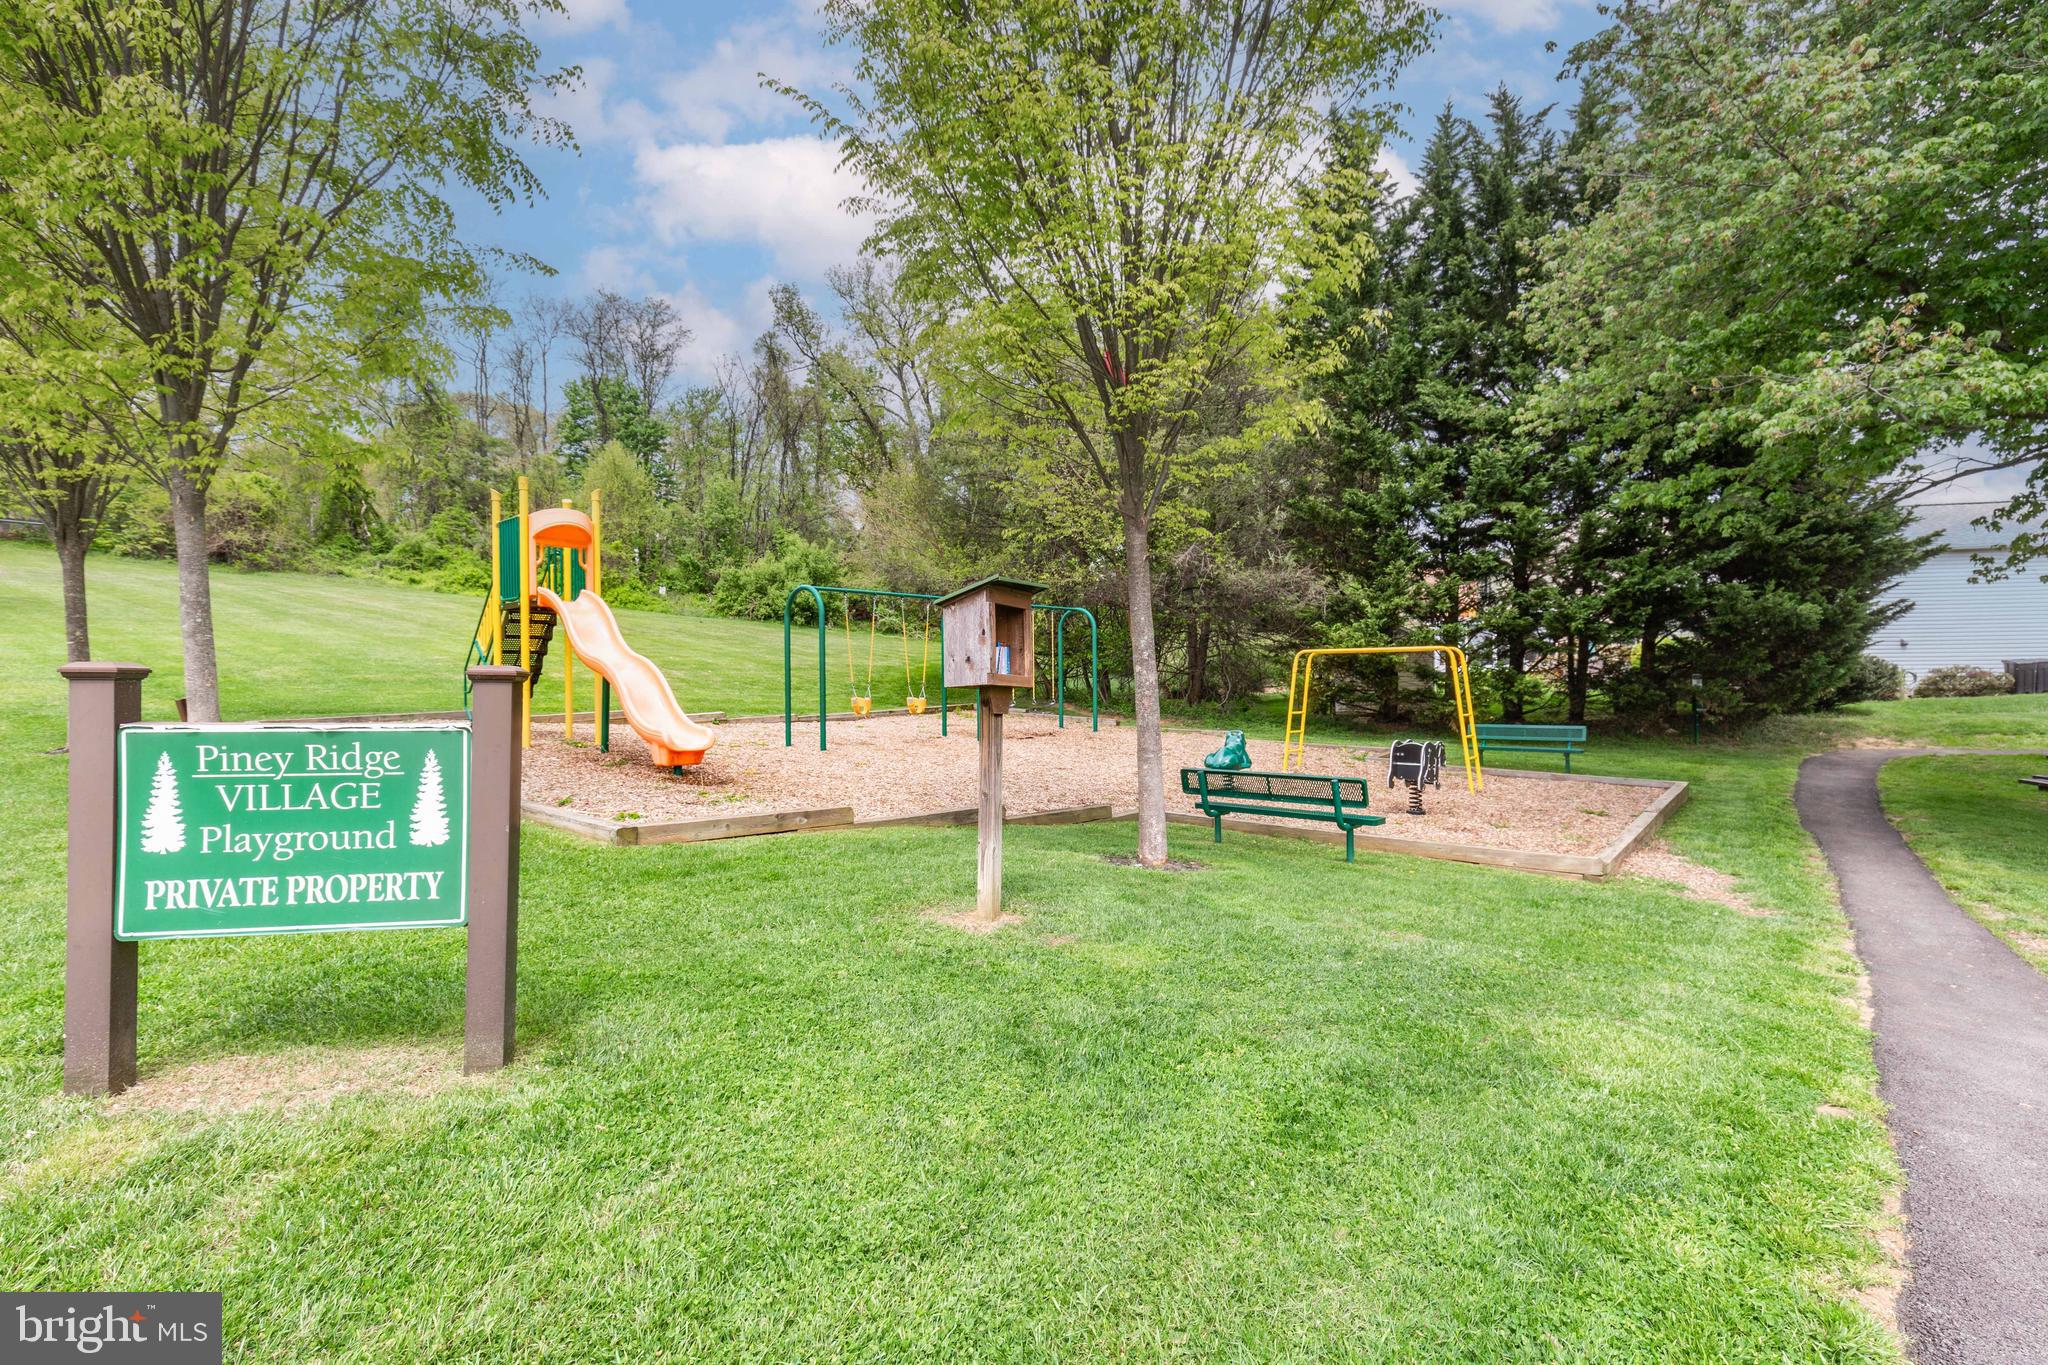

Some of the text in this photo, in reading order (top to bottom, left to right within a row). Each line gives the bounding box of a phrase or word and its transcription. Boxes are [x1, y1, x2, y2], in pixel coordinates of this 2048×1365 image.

[195, 742, 400, 780] Piney Ridge
[215, 782, 382, 812] VILLAGE
[199, 821, 397, 861] Playground
[144, 871, 444, 911] PRIVATE PROPERTY
